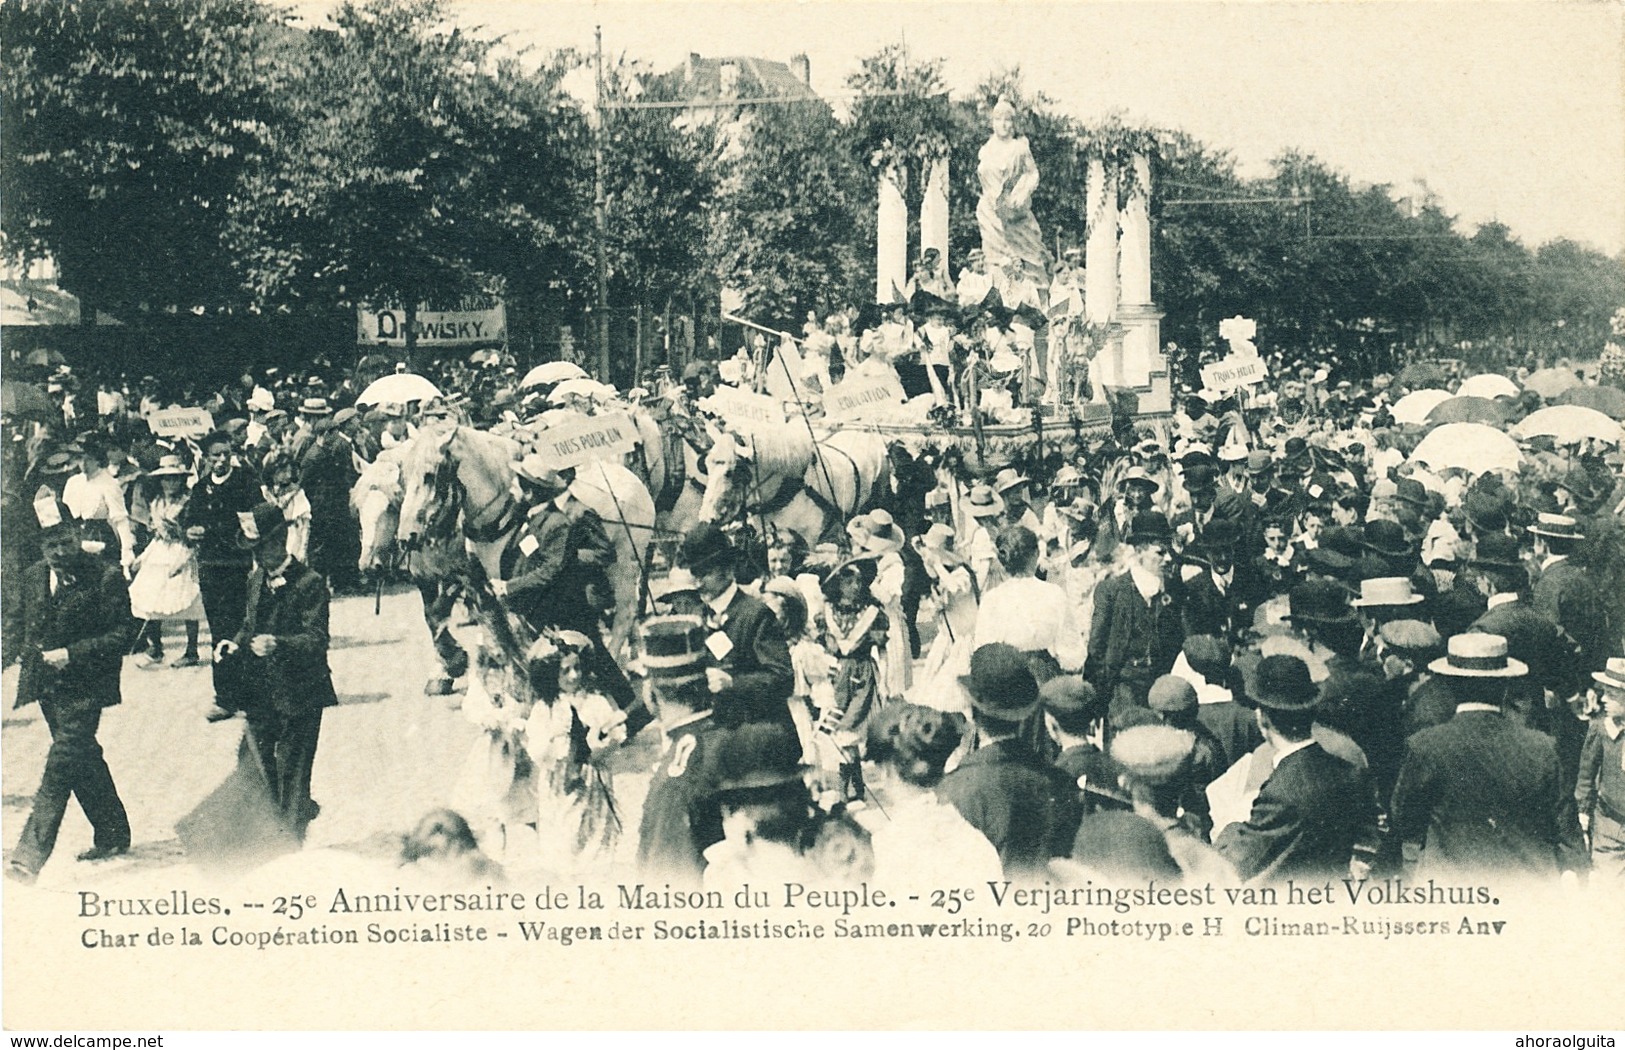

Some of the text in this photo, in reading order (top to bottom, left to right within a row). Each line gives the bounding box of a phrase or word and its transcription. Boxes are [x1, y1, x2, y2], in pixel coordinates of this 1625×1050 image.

[553, 427, 623, 456] TOUS POUR UN
